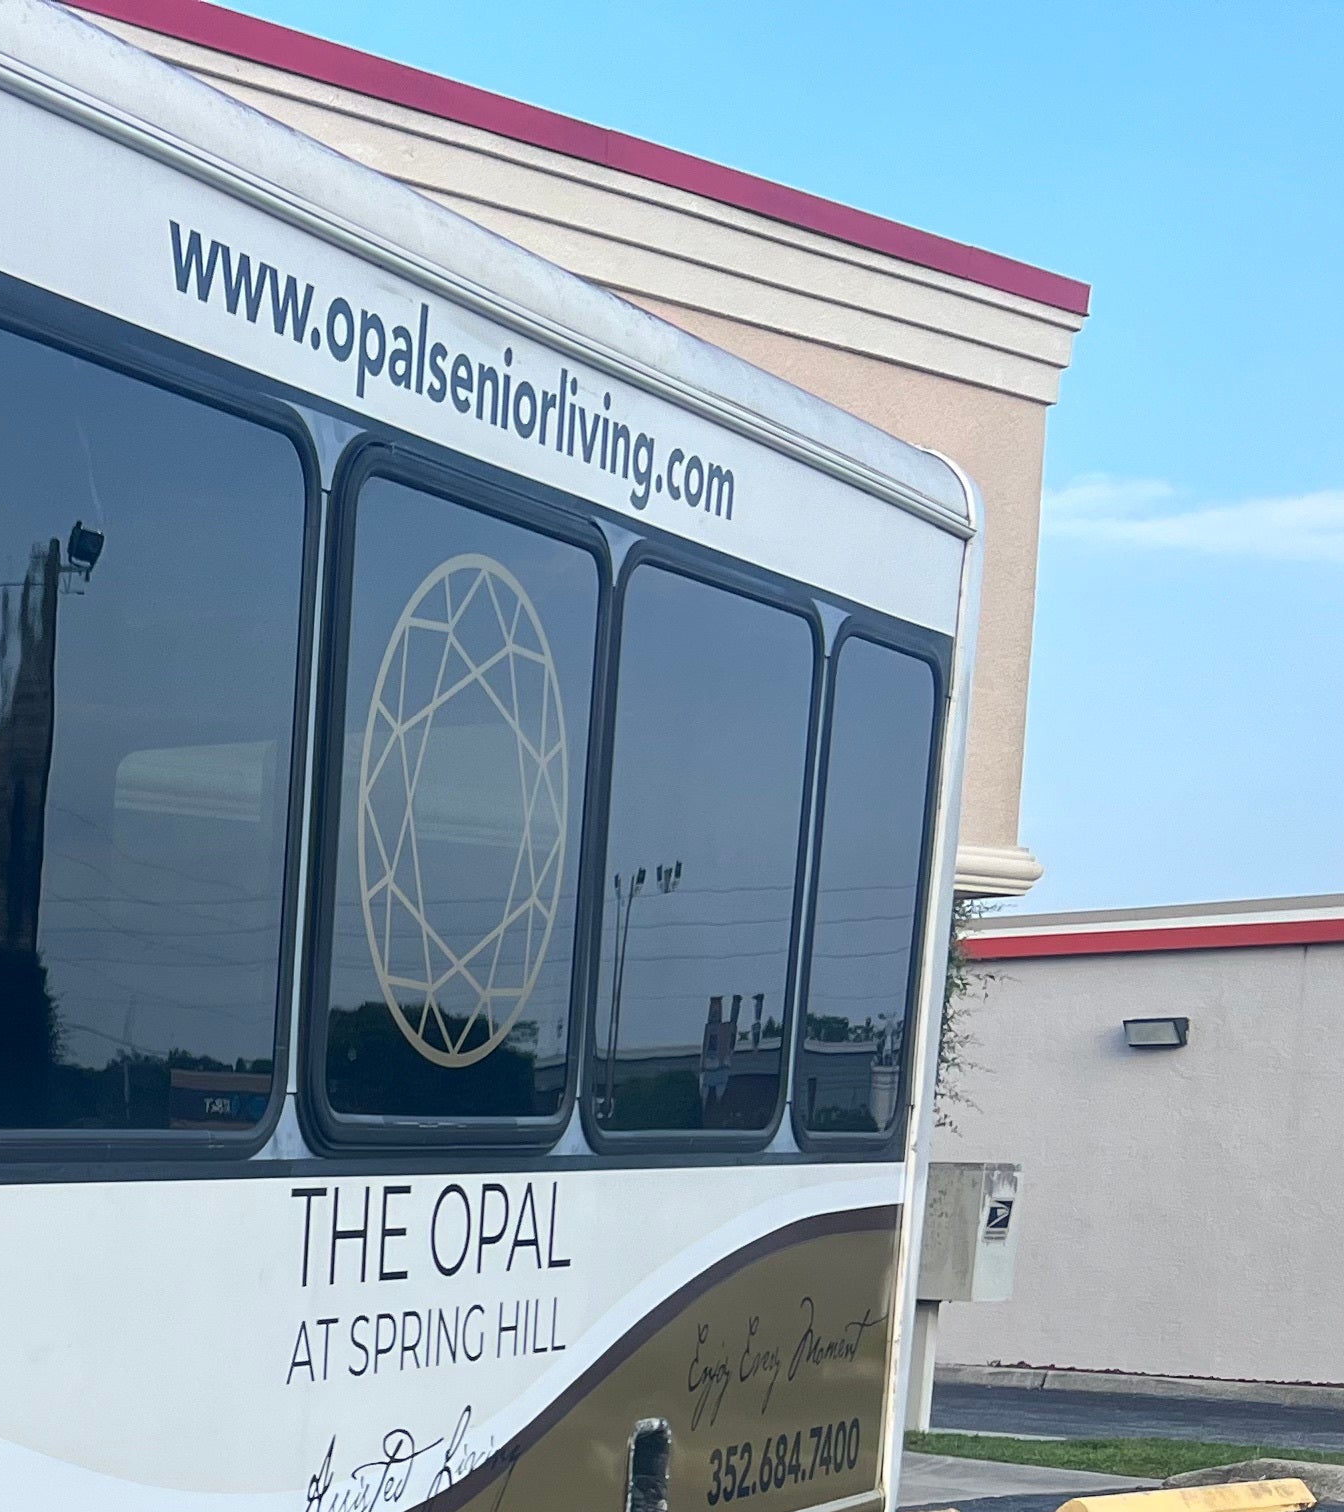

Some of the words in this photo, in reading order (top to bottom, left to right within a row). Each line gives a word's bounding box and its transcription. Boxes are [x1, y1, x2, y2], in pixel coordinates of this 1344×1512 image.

[169, 219, 735, 521] www.opalseniorliving.com
[291, 1185, 412, 1287] THE
[429, 1181, 572, 1277] OPAL
[287, 1317, 339, 1385] AT
[347, 1303, 485, 1377] SPRING
[497, 1296, 567, 1359] HILL
[688, 1323, 732, 1431] Enjoy
[739, 1315, 781, 1415] Every
[788, 1296, 889, 1382] Moment
[707, 1417, 861, 1506] 352.684.7400
